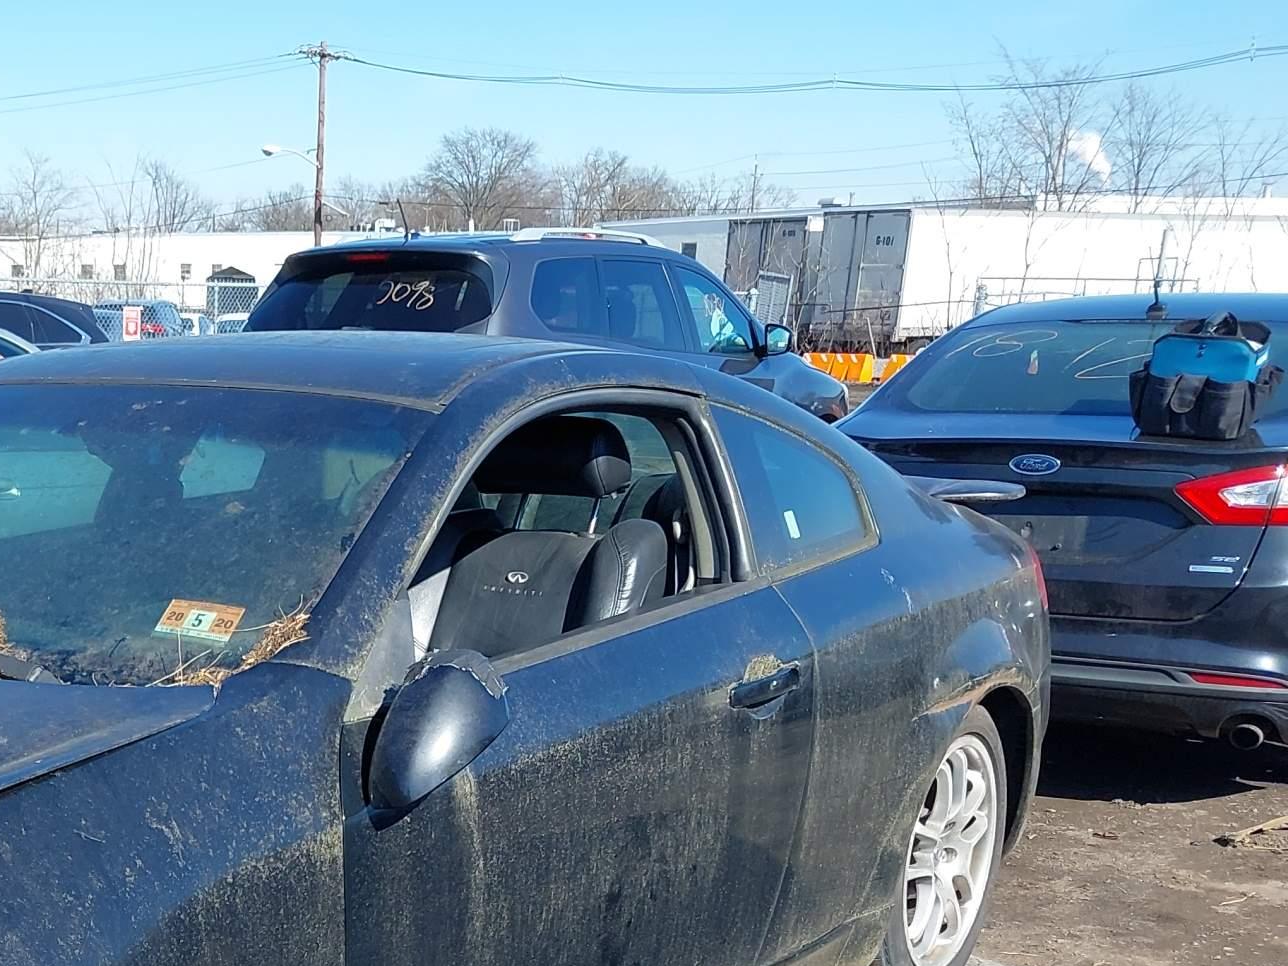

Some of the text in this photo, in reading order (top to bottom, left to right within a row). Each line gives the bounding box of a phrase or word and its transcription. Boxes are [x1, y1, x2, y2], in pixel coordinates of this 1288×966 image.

[167, 610, 234, 630] 20 5 20
